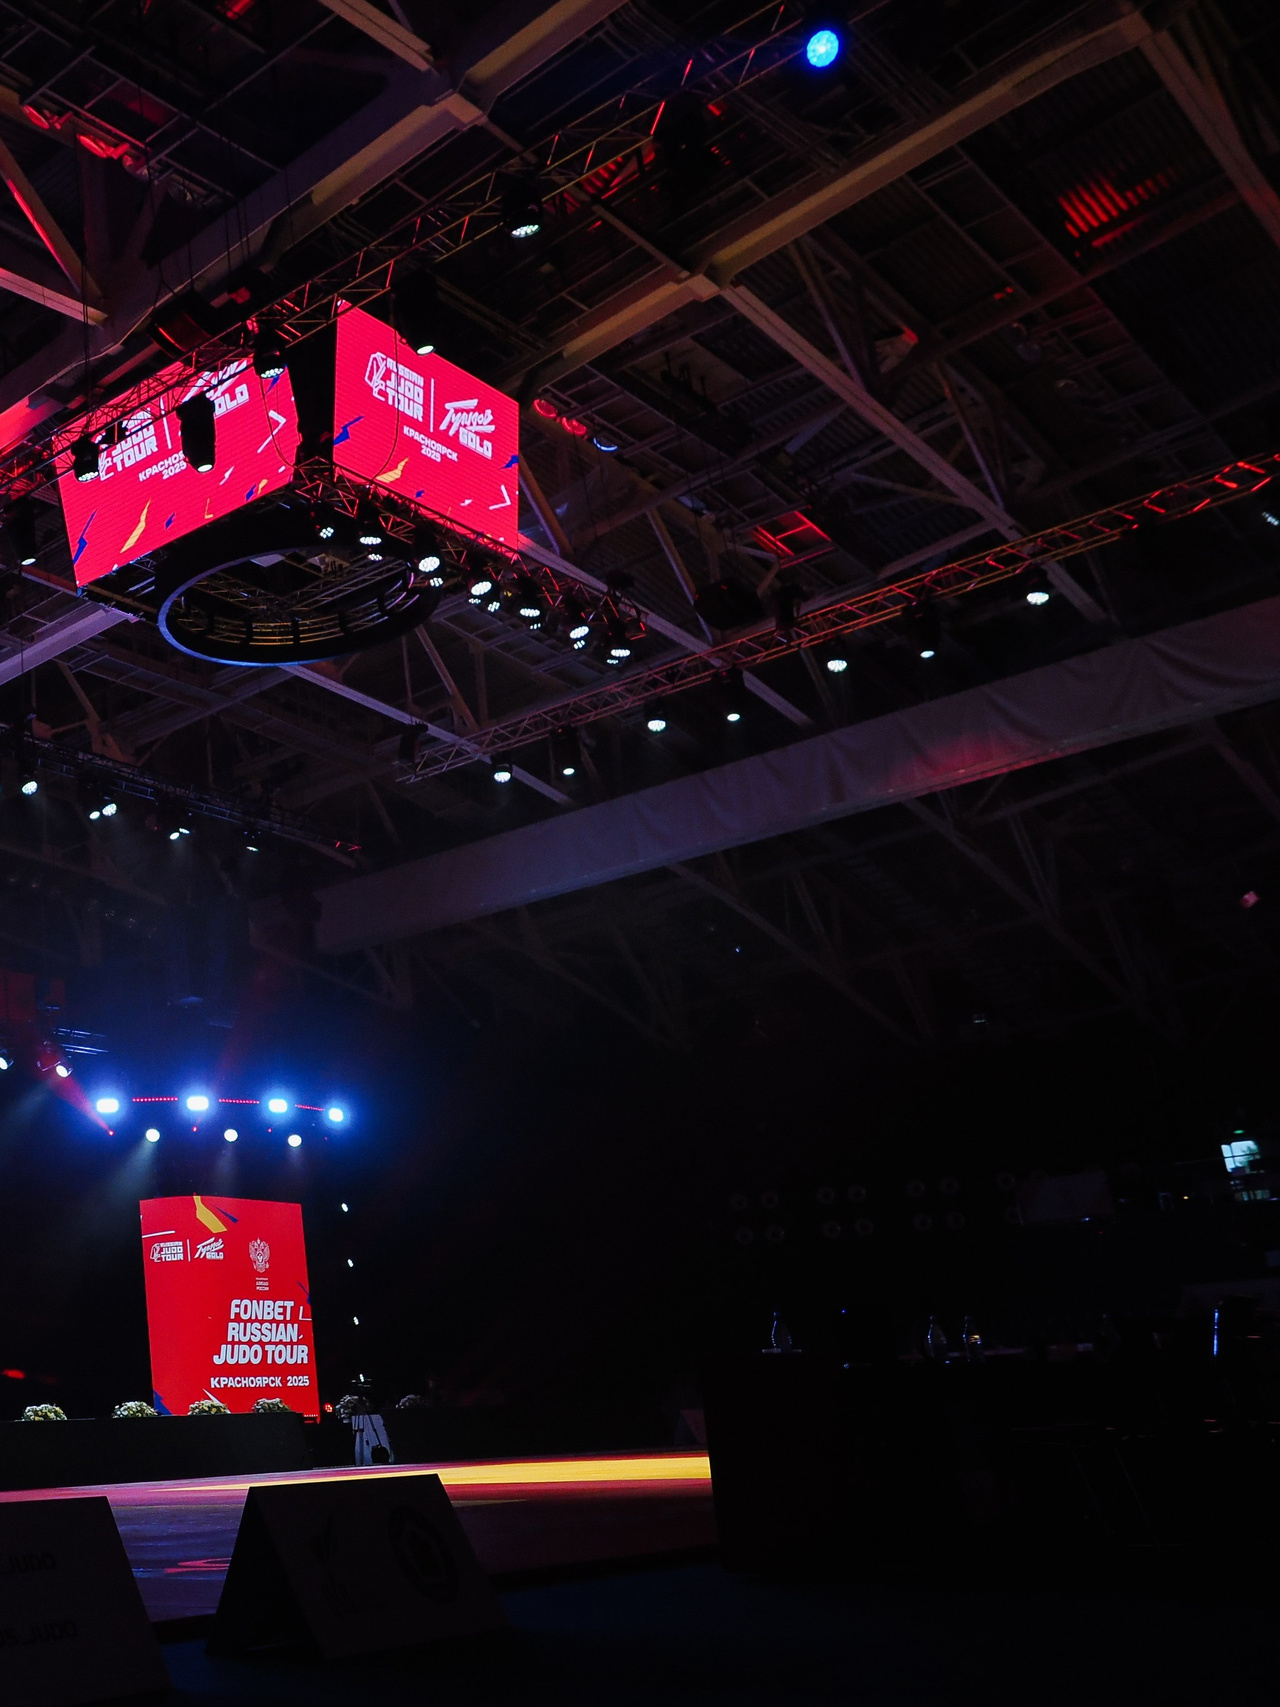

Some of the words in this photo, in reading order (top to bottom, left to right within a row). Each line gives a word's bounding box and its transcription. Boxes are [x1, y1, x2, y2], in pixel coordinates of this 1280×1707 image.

[386, 372, 424, 404] JUDO
[214, 383, 250, 416] OLD
[386, 387, 424, 422] TOUR
[113, 435, 159, 472] TOUR
[403, 425, 458, 462] КРАСНОЯРСК
[421, 445, 442, 462] 2025
[459, 427, 493, 459] GOLD
[162, 460, 187, 480] 2025
[160, 1253, 184, 1261] TOUR
[230, 1299, 294, 1320] FONBET
[227, 1322, 299, 1342] RUSSIAN
[213, 1344, 262, 1364] JUDO
[265, 1344, 309, 1364] TOUR
[210, 1377, 282, 1388] КРАСНОЯРСК
[286, 1376, 310, 1387] 2025
